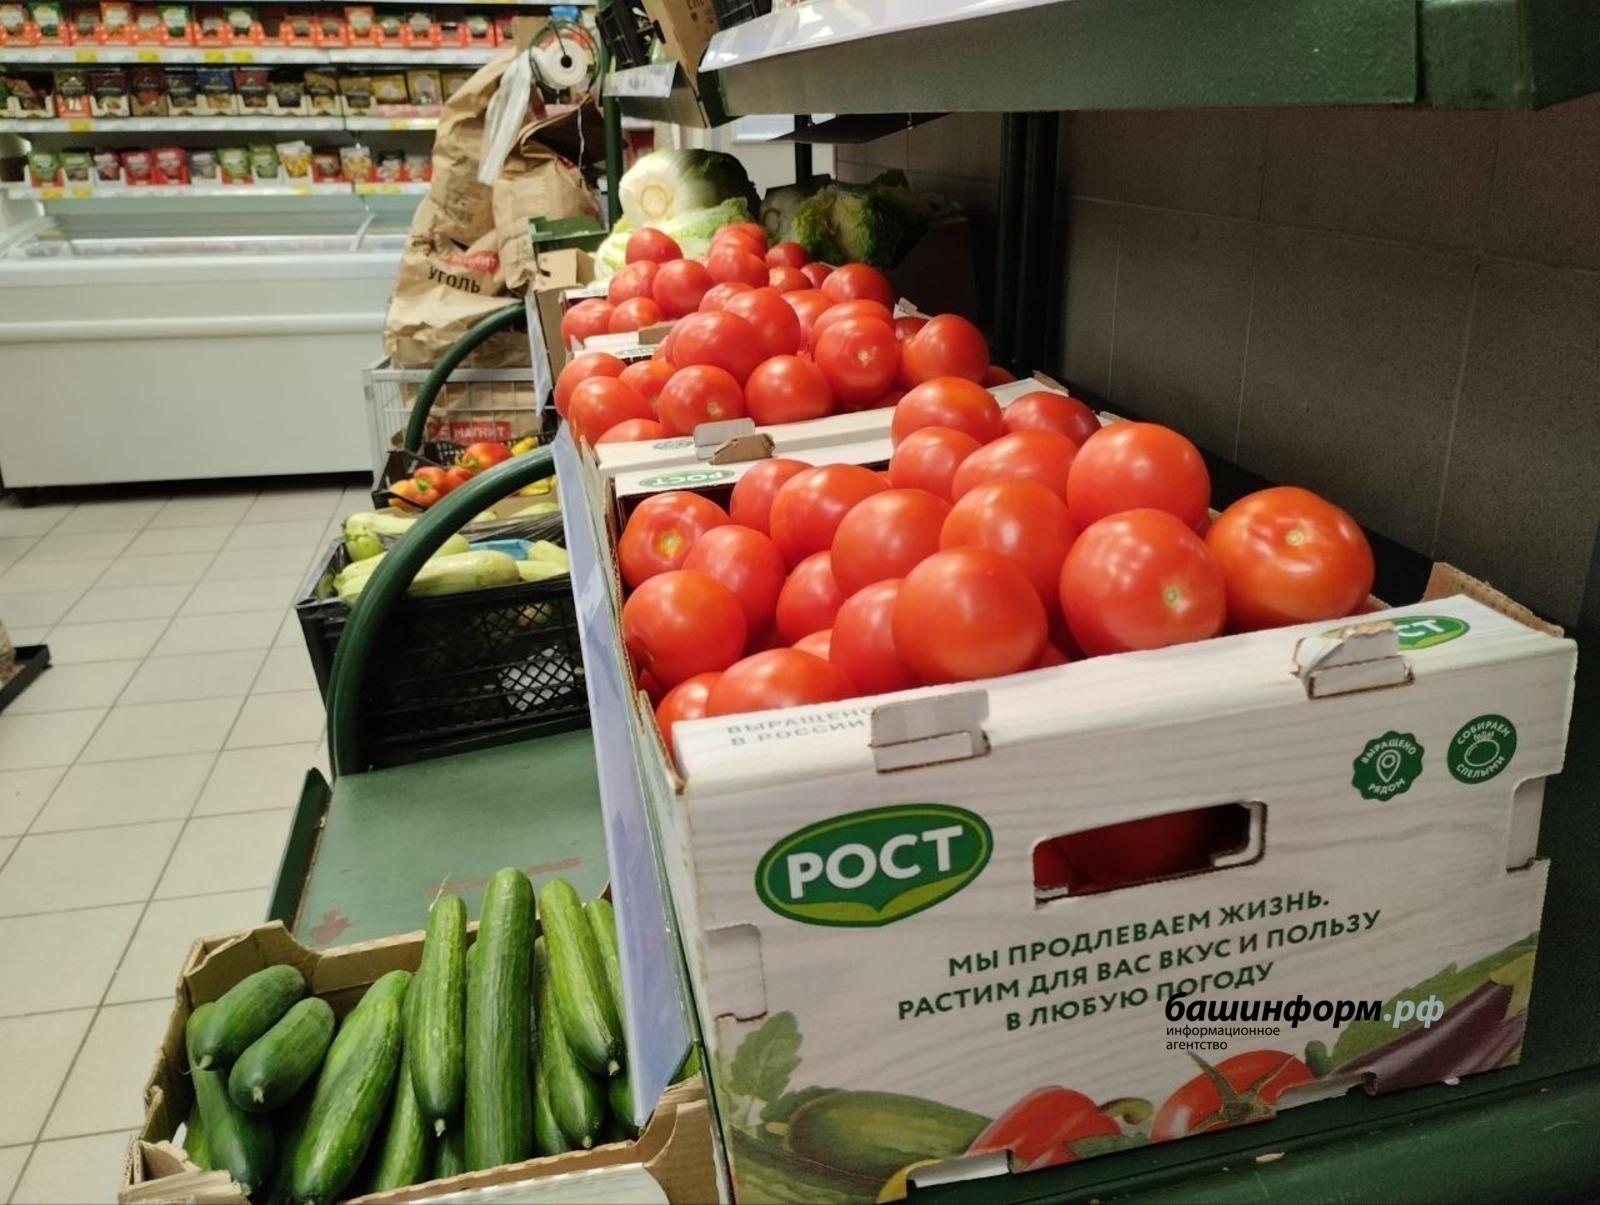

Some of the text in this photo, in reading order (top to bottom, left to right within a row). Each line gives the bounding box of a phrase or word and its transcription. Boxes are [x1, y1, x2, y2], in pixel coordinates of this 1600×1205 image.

[428, 266, 480, 294] УГОЛЬ
[453, 426, 506, 439] МАГНИТ
[652, 471, 723, 486] РОСТ
[1395, 619, 1445, 637] СТ
[731, 719, 865, 746] В РОССИИ
[1457, 720, 1511, 745] СОБИРАЕМ
[1361, 738, 1417, 764] ВЫРАЩЕНО
[1456, 755, 1505, 779] СПЕЛЫМИ
[1368, 778, 1406, 795] РЯДОМ
[787, 825, 963, 899] РОСТ
[949, 890, 1329, 977] МЫ ПРОДЛЕВАЕМ ЖИЗНЬ.
[899, 909, 1381, 1020] РАСТИМ ДЛЯ ВАС ВКУС И ПОЛЬЗУ
[1006, 961, 1274, 1031] В ЛЮБУЮ ПОГОДУ
